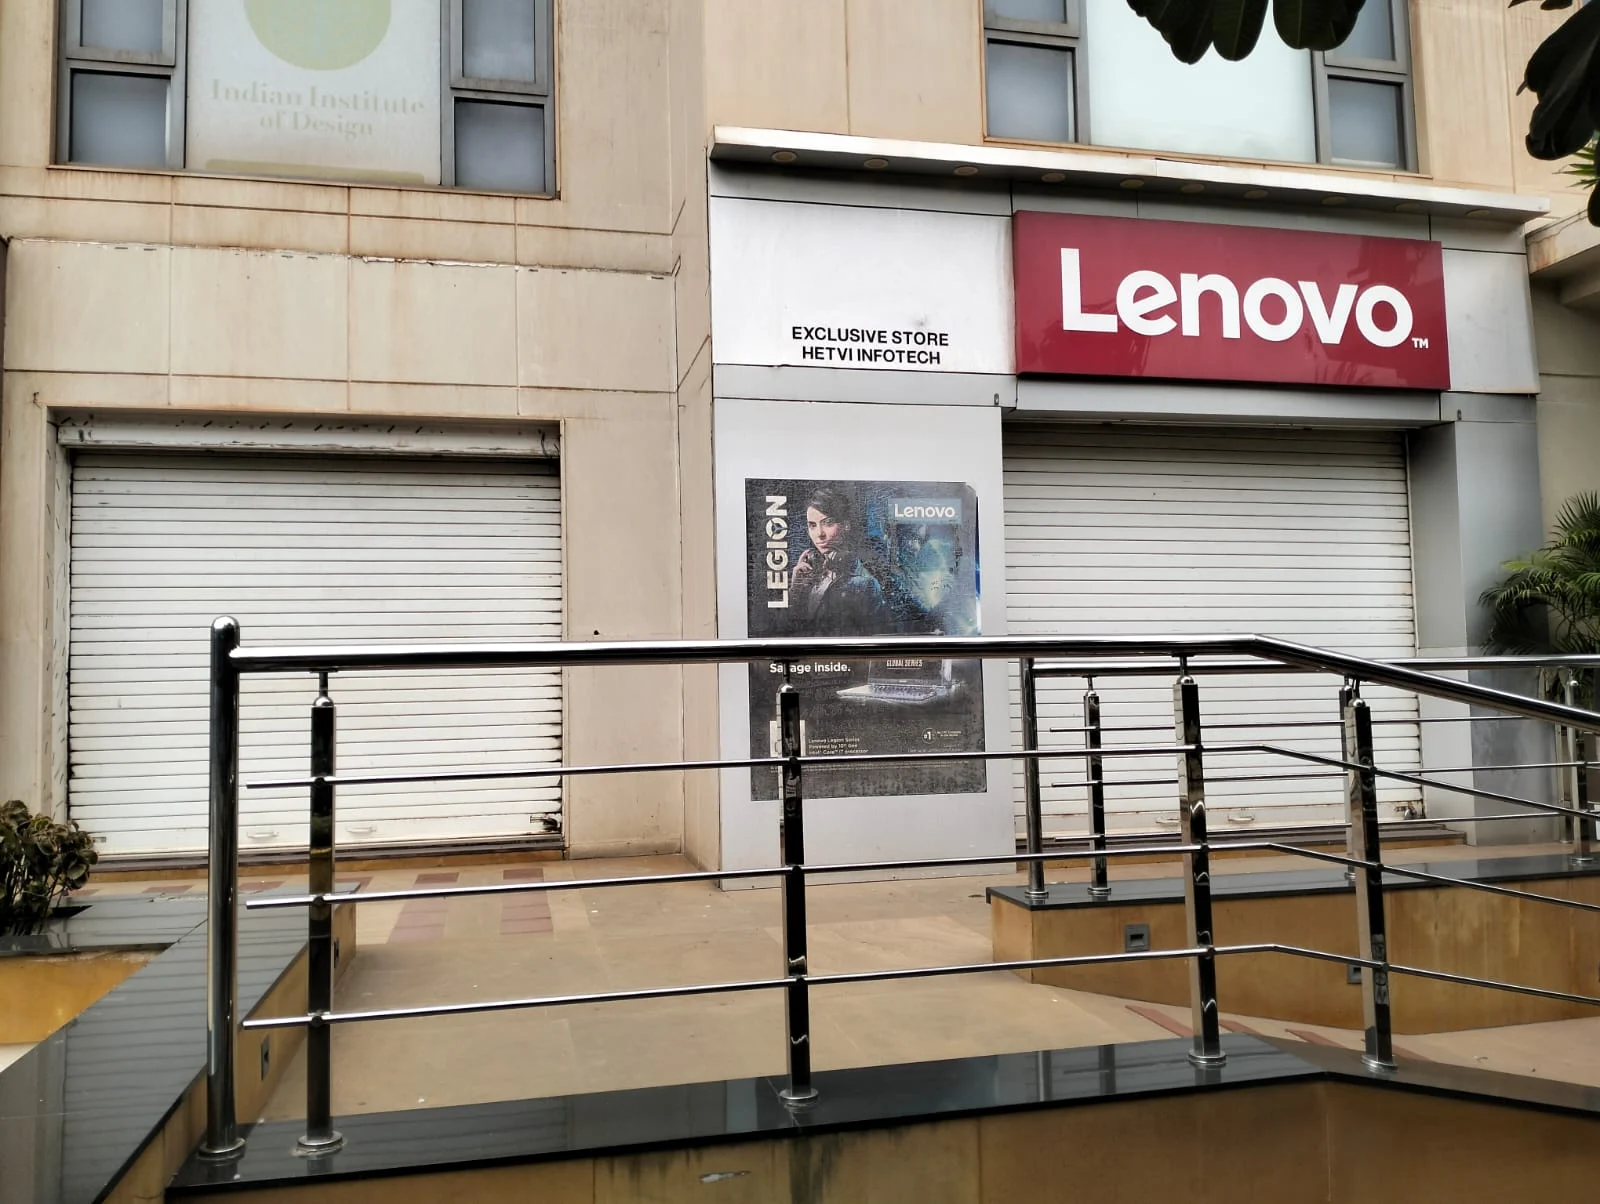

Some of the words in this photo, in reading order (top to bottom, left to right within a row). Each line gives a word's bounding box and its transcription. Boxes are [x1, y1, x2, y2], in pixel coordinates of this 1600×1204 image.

[212, 79, 301, 106] Indian
[309, 86, 425, 115] Institute
[260, 111, 287, 130] of
[292, 111, 373, 140] Design
[1060, 247, 1414, 348] Lenovo
[792, 326, 888, 344] EXCLUSIVE
[891, 331, 949, 347] STORE
[802, 346, 853, 361] HETVI
[857, 348, 941, 365] INFOTECH
[894, 503, 956, 519] Lenovo
[765, 495, 789, 609] LEGION
[769, 662, 811, 675] Saage
[814, 662, 851, 672] inside.
